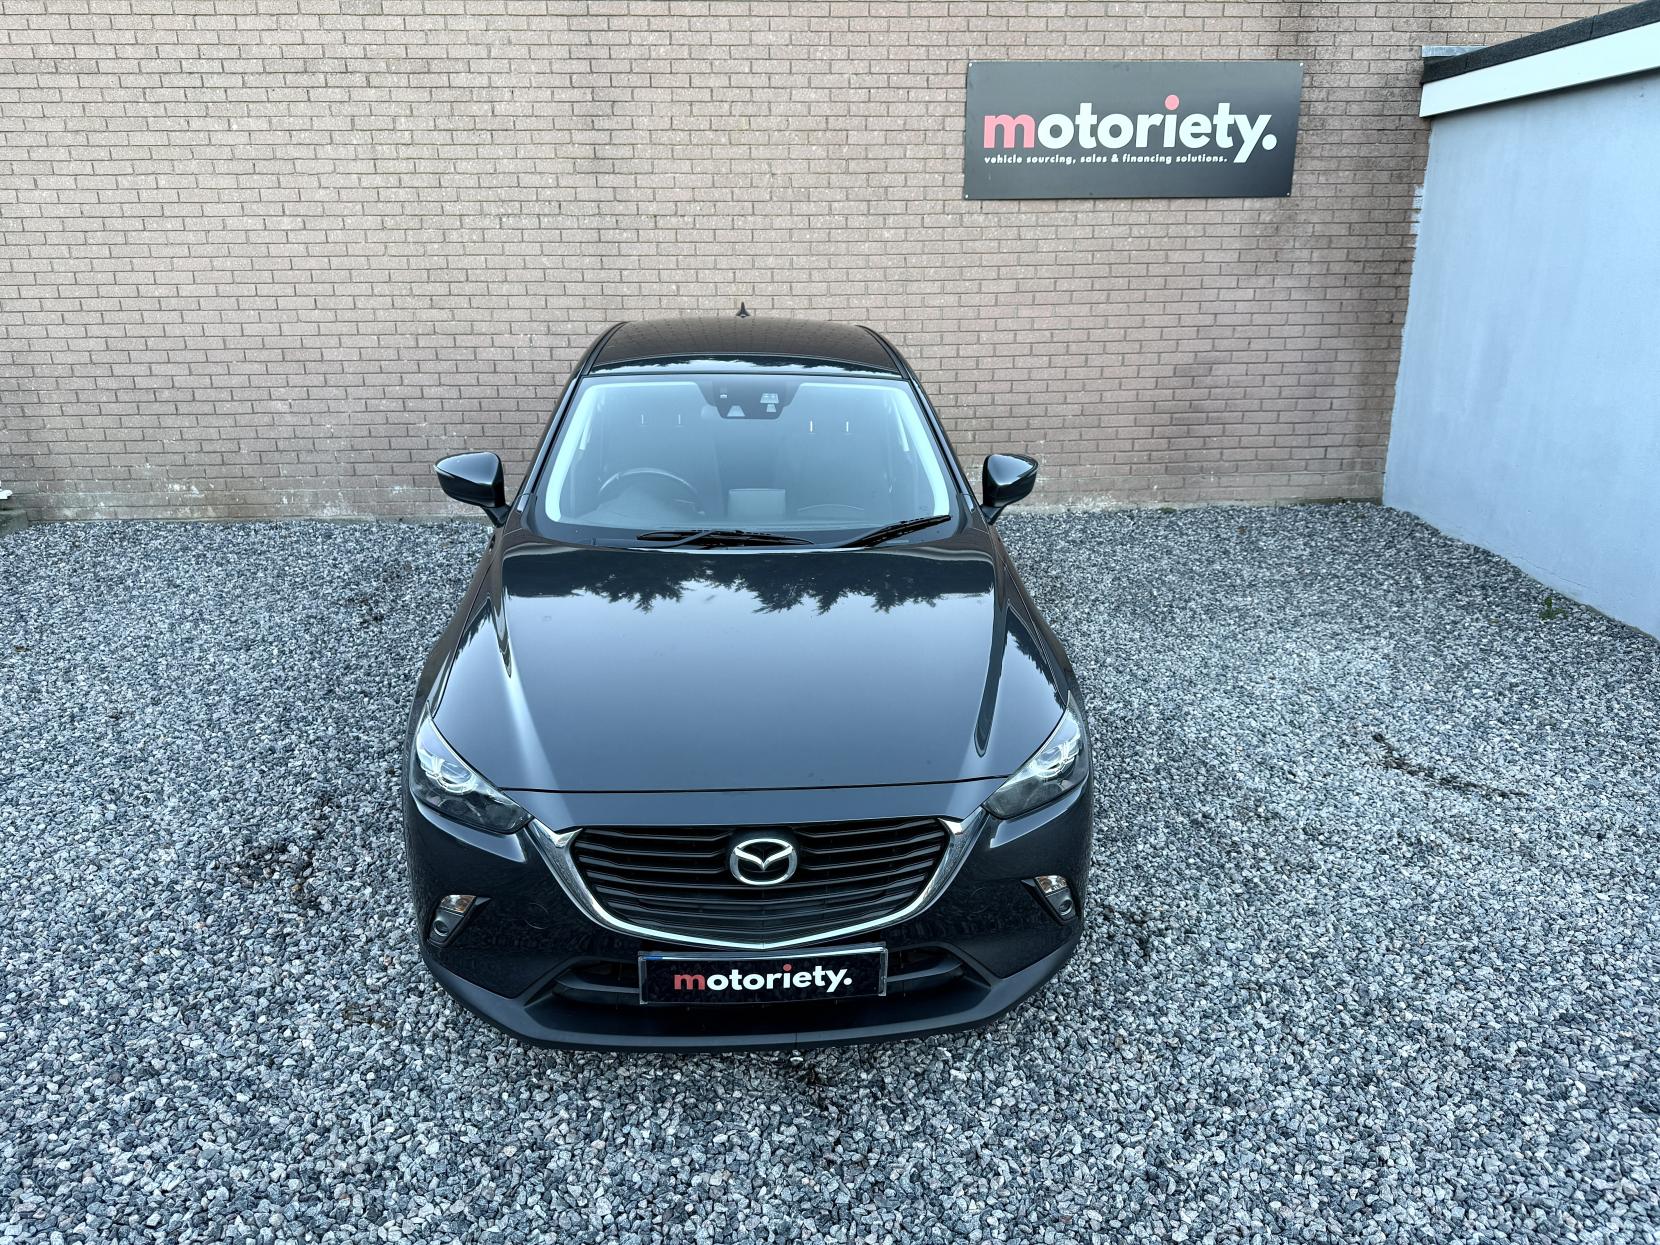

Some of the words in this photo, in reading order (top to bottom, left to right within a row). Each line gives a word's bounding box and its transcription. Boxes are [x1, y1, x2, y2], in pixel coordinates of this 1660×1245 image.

[983, 94, 1278, 163] motoriety.
[984, 154, 1023, 164] vehicle
[1026, 154, 1077, 165] sourcing,
[1080, 153, 1107, 163] sales
[1110, 153, 1119, 163] &
[1122, 153, 1172, 165] financing
[1175, 153, 1228, 163] solutions.
[673, 963, 853, 993] motoriety.
